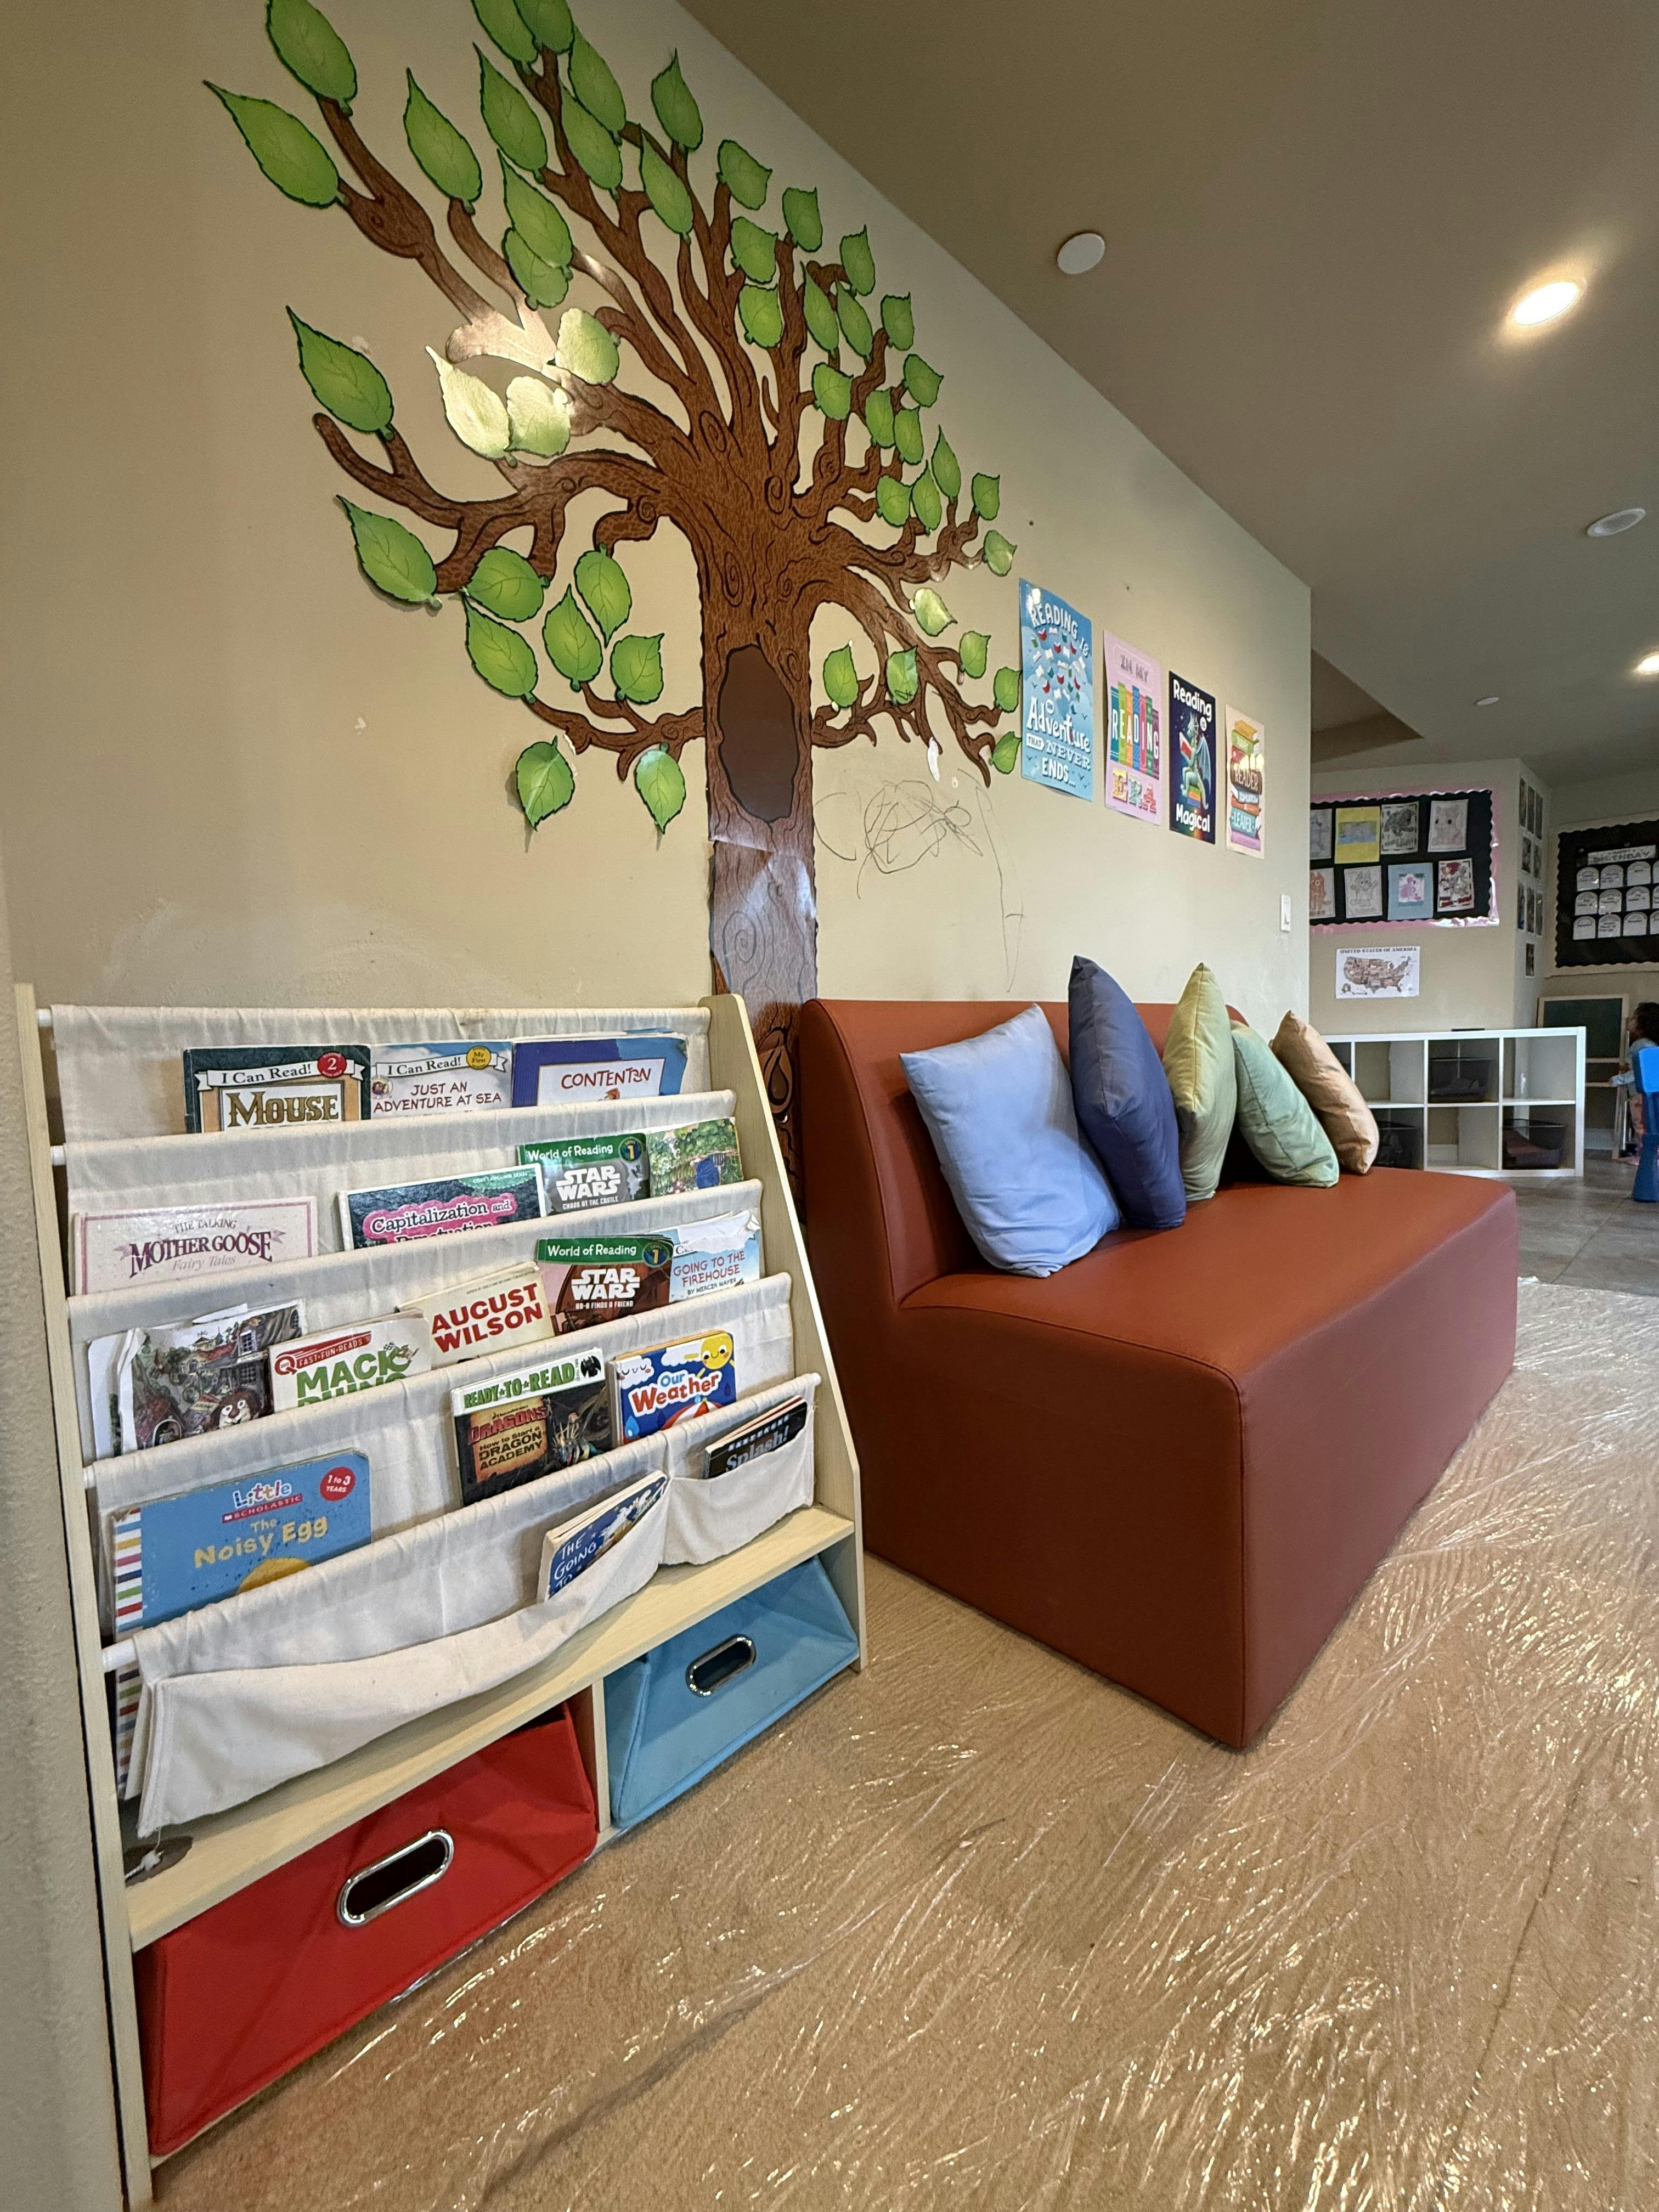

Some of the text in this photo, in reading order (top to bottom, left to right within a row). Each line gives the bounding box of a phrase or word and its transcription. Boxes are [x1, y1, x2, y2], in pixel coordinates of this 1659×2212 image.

[1030, 602, 1079, 640] READING
[1136, 663, 1149, 683] MY
[1173, 679, 1212, 723] Reading
[1027, 696, 1091, 753] Adventure
[1112, 708, 1159, 759] READING
[1028, 736, 1091, 771] THAT NEVER
[1113, 769, 1157, 815] ERA
[1235, 768, 1259, 792] READER
[1176, 803, 1210, 833] Magical
[222, 1073, 229, 1085] I
[233, 1069, 265, 1085] Can
[270, 1064, 312, 1080] Read!
[328, 1058, 337, 1070] 2
[387, 1057, 462, 1075] I Can Read!
[411, 1081, 468, 1096] JUST AN
[225, 1091, 340, 1127] MOUSE
[374, 1092, 502, 1113] ADVENTURE AT SEA
[528, 1142, 614, 1162] World of Reading
[627, 1145, 634, 1159] 1
[556, 1165, 620, 1186] STAR
[556, 1180, 620, 1201] WARS
[600, 1195, 619, 1204] CASTLE
[173, 1218, 238, 1234] THE TALKING
[372, 1201, 488, 1233] Capitalization
[492, 1200, 510, 1211] and
[129, 1231, 273, 1278] MOTHER GOOSE
[172, 1255, 236, 1272] Fairy Tales
[548, 1244, 637, 1258] World of Reading
[652, 1249, 658, 1264] 1
[674, 1250, 746, 1277] GOING TO THE
[571, 1267, 640, 1285] STAR
[681, 1263, 741, 1288] FIREHOUSE
[696, 1282, 718, 1293] MERCER
[719, 1277, 737, 1286] MAYER
[571, 1281, 640, 1301] WARS
[432, 1283, 538, 1335] AUGUST
[614, 1300, 634, 1308] FRIEND
[434, 1302, 543, 1353] WILSON
[298, 1338, 363, 1367] FAST FUN READS
[296, 1347, 412, 1398] MACK
[660, 1373, 685, 1387] Our
[463, 1383, 500, 1409] READY
[503, 1377, 523, 1398] TO
[528, 1362, 575, 1392] READ
[631, 1374, 719, 1413] Weather
[469, 1406, 548, 1446] DRAGONS
[479, 1441, 499, 1452] How
[512, 1428, 533, 1440] Start
[479, 1431, 542, 1461] DRAGON
[725, 1425, 789, 1472] Splash!
[479, 1440, 543, 1470] ACADEMY
[328, 1475, 333, 1484] 1
[342, 1475, 351, 1486] 3
[233, 1480, 292, 1509] Little
[234, 1495, 302, 1519] SCHOLASTIC
[251, 1517, 278, 1532] The
[194, 1515, 328, 1569] Noisy Egg
[558, 1532, 586, 1560] THE
[554, 1541, 597, 1580] GOING
